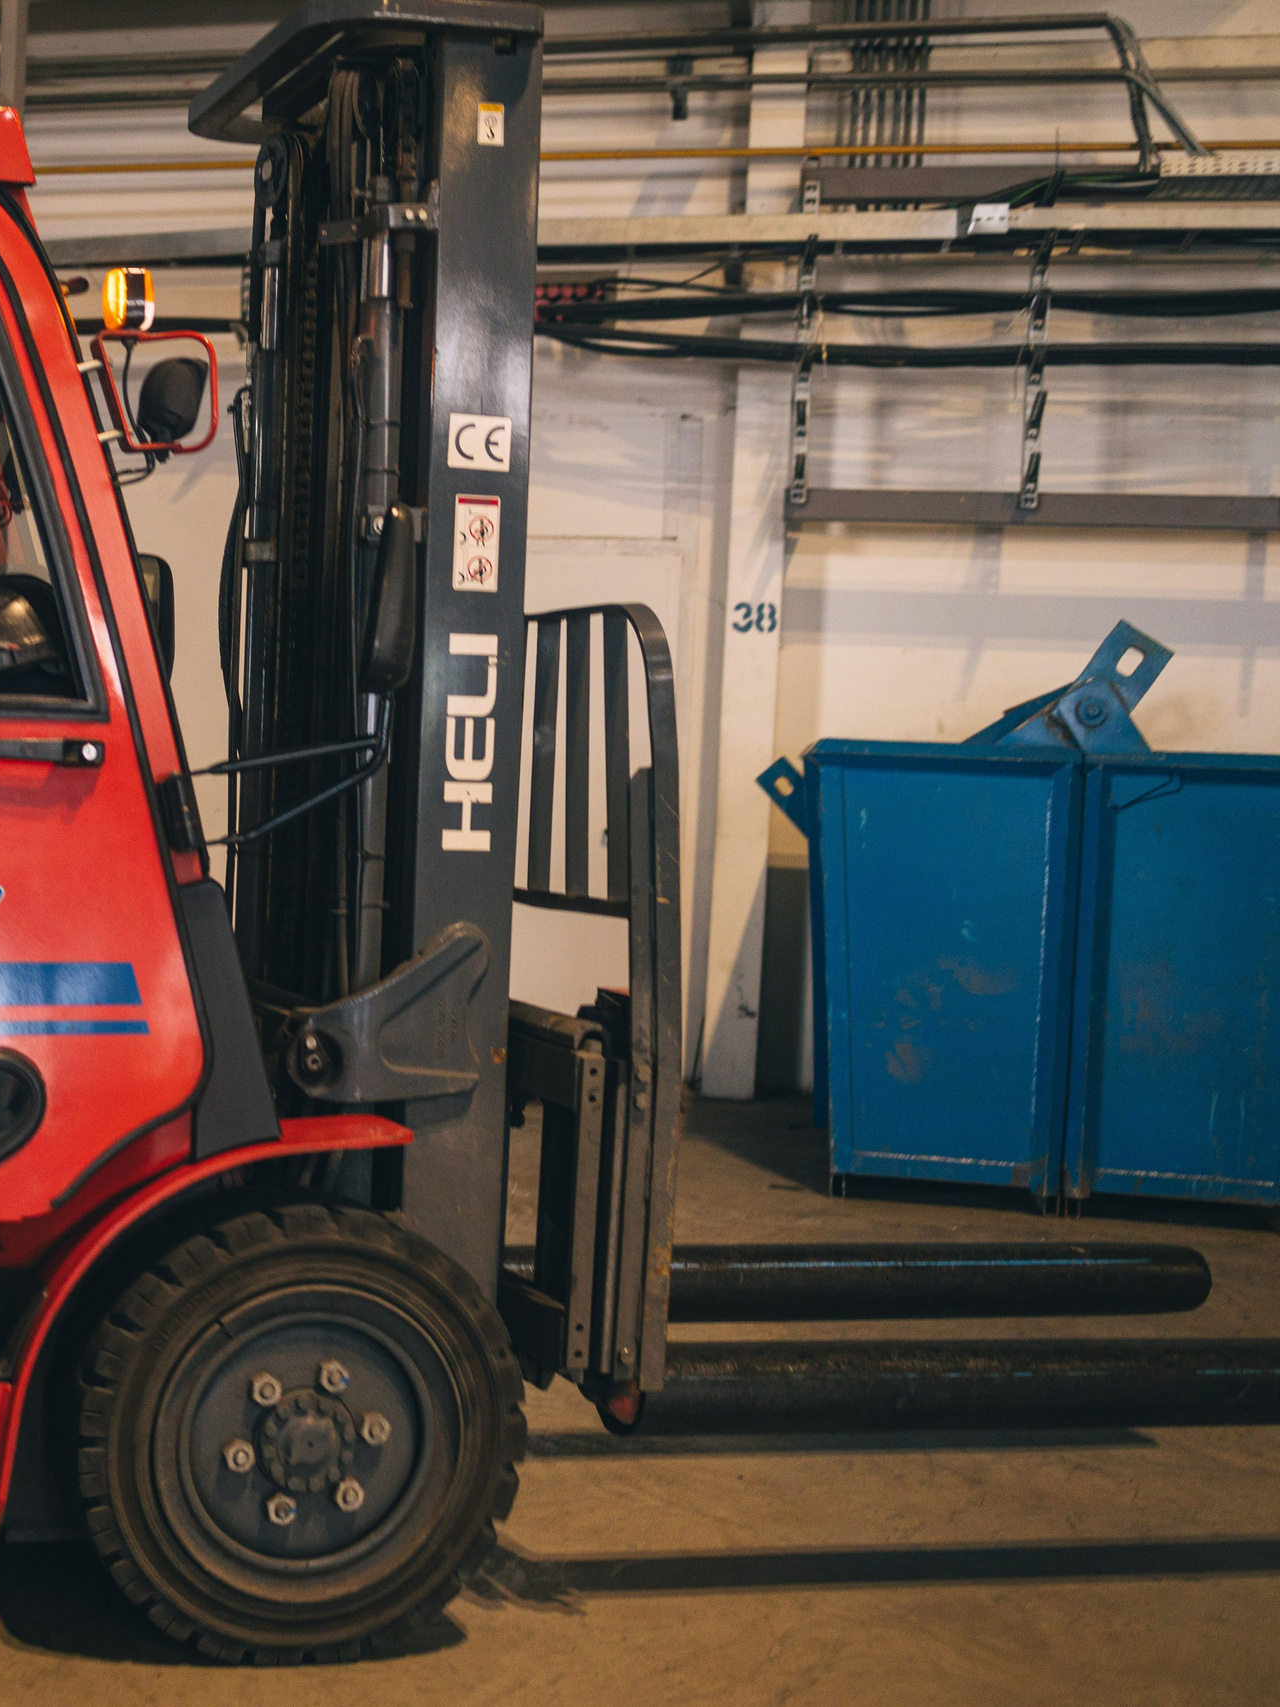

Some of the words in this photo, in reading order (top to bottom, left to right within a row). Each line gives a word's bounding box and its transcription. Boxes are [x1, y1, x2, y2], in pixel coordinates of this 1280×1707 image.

[454, 423, 506, 463] CE
[732, 601, 777, 633] 38
[441, 632, 499, 852] HELI
